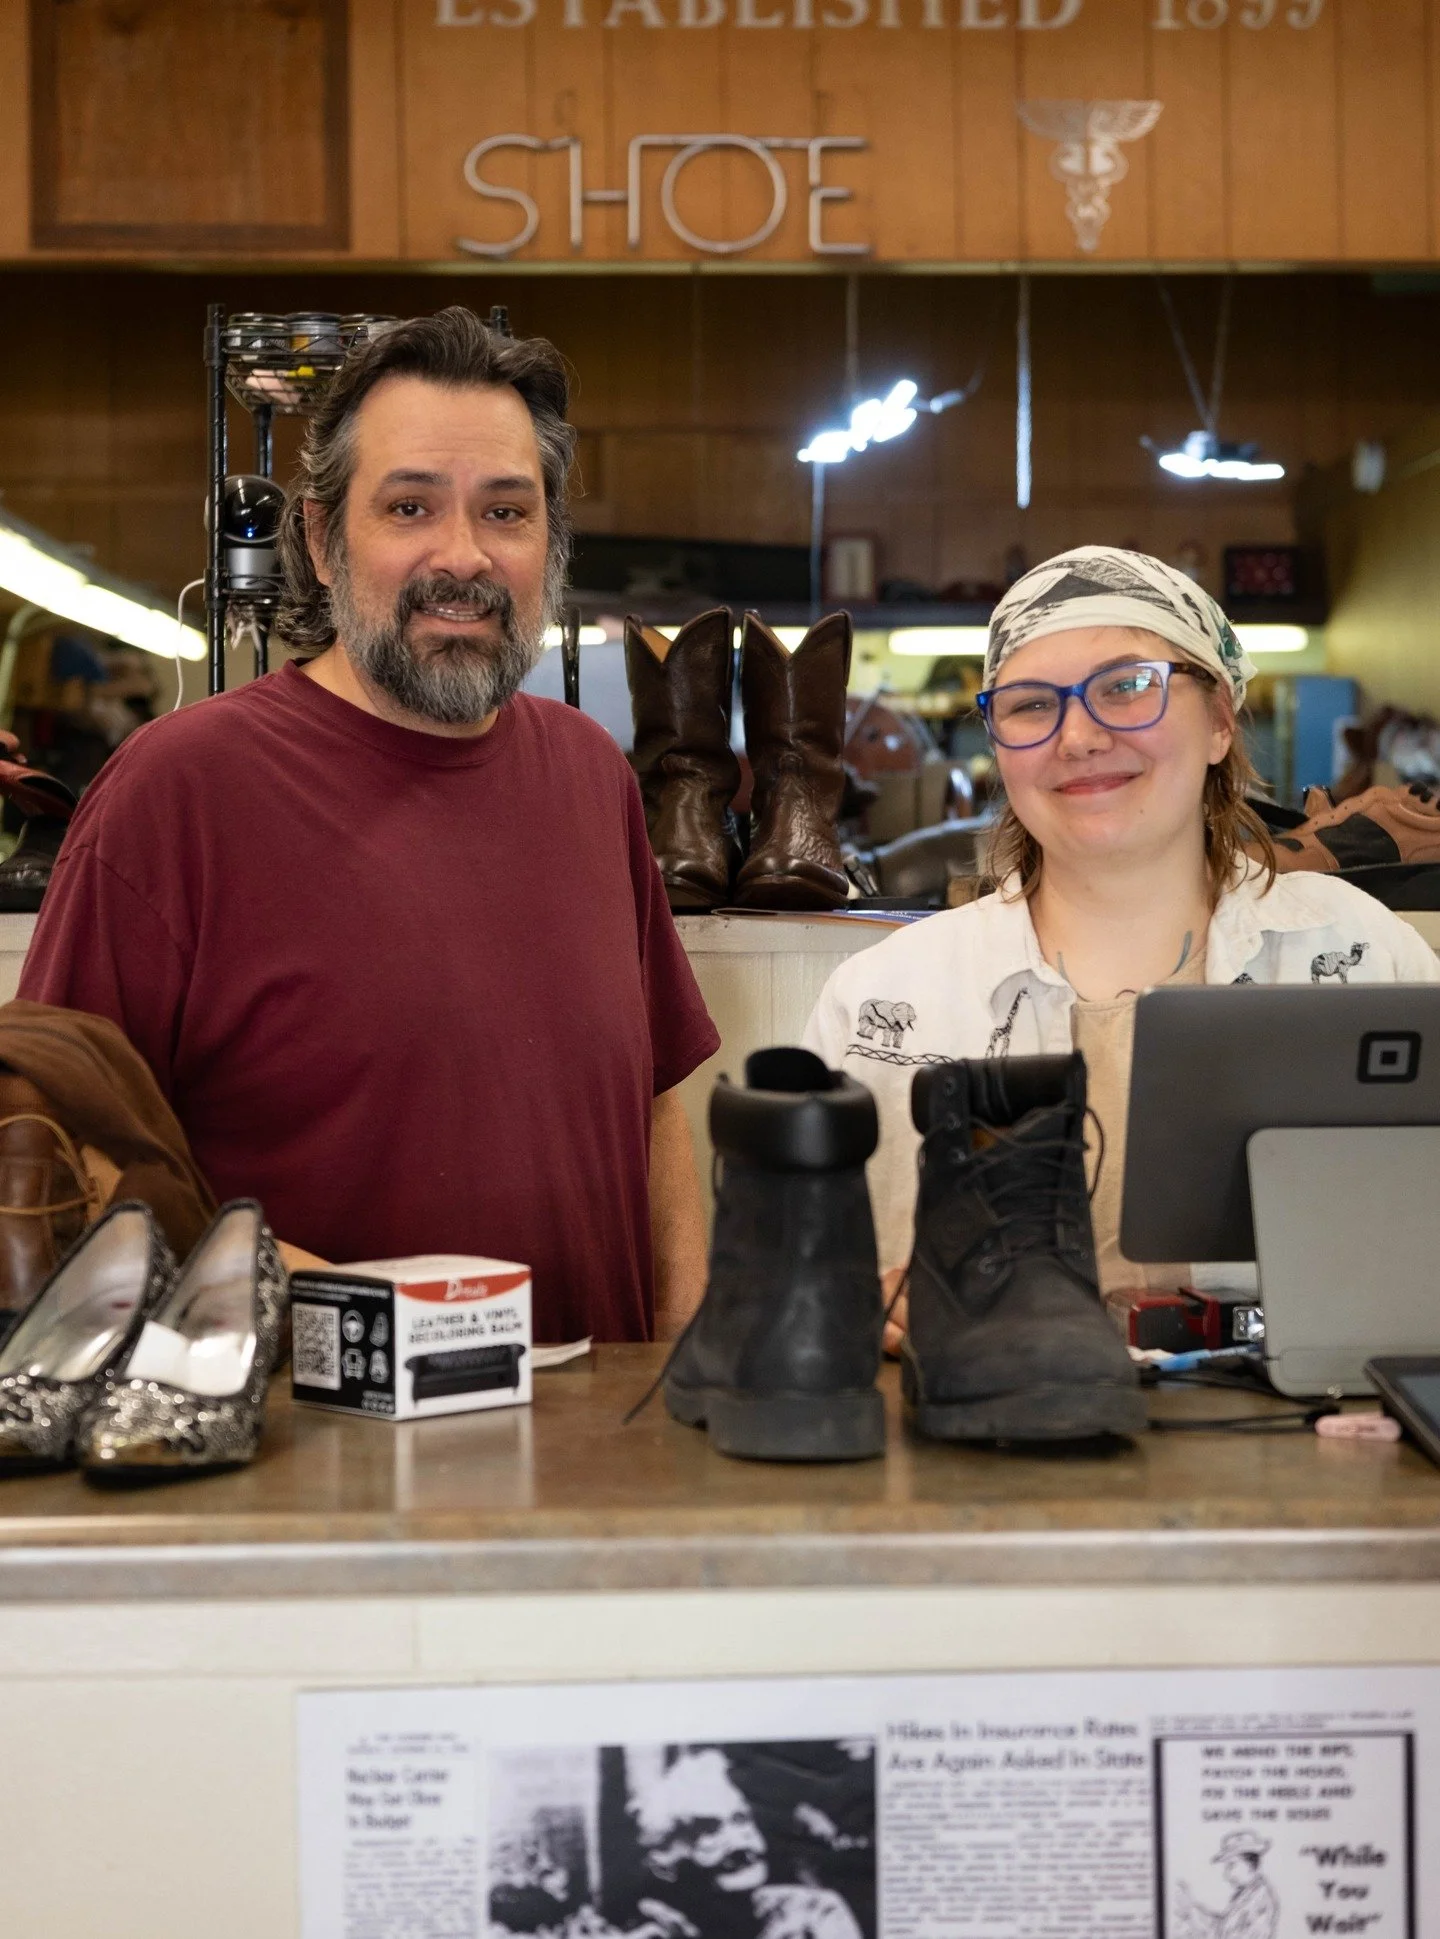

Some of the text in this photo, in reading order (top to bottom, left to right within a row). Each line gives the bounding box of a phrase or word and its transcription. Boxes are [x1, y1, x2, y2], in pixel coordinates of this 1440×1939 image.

[455, 133, 871, 257] SHOE
[886, 1720, 943, 1740] Hikes
[977, 1720, 1077, 1740] Insurance
[1083, 1716, 1137, 1737] Rates
[887, 1753, 924, 1770] Are
[932, 1750, 993, 1775] Again
[1001, 1750, 1064, 1770] Asked
[1319, 1880, 1369, 1900] You
